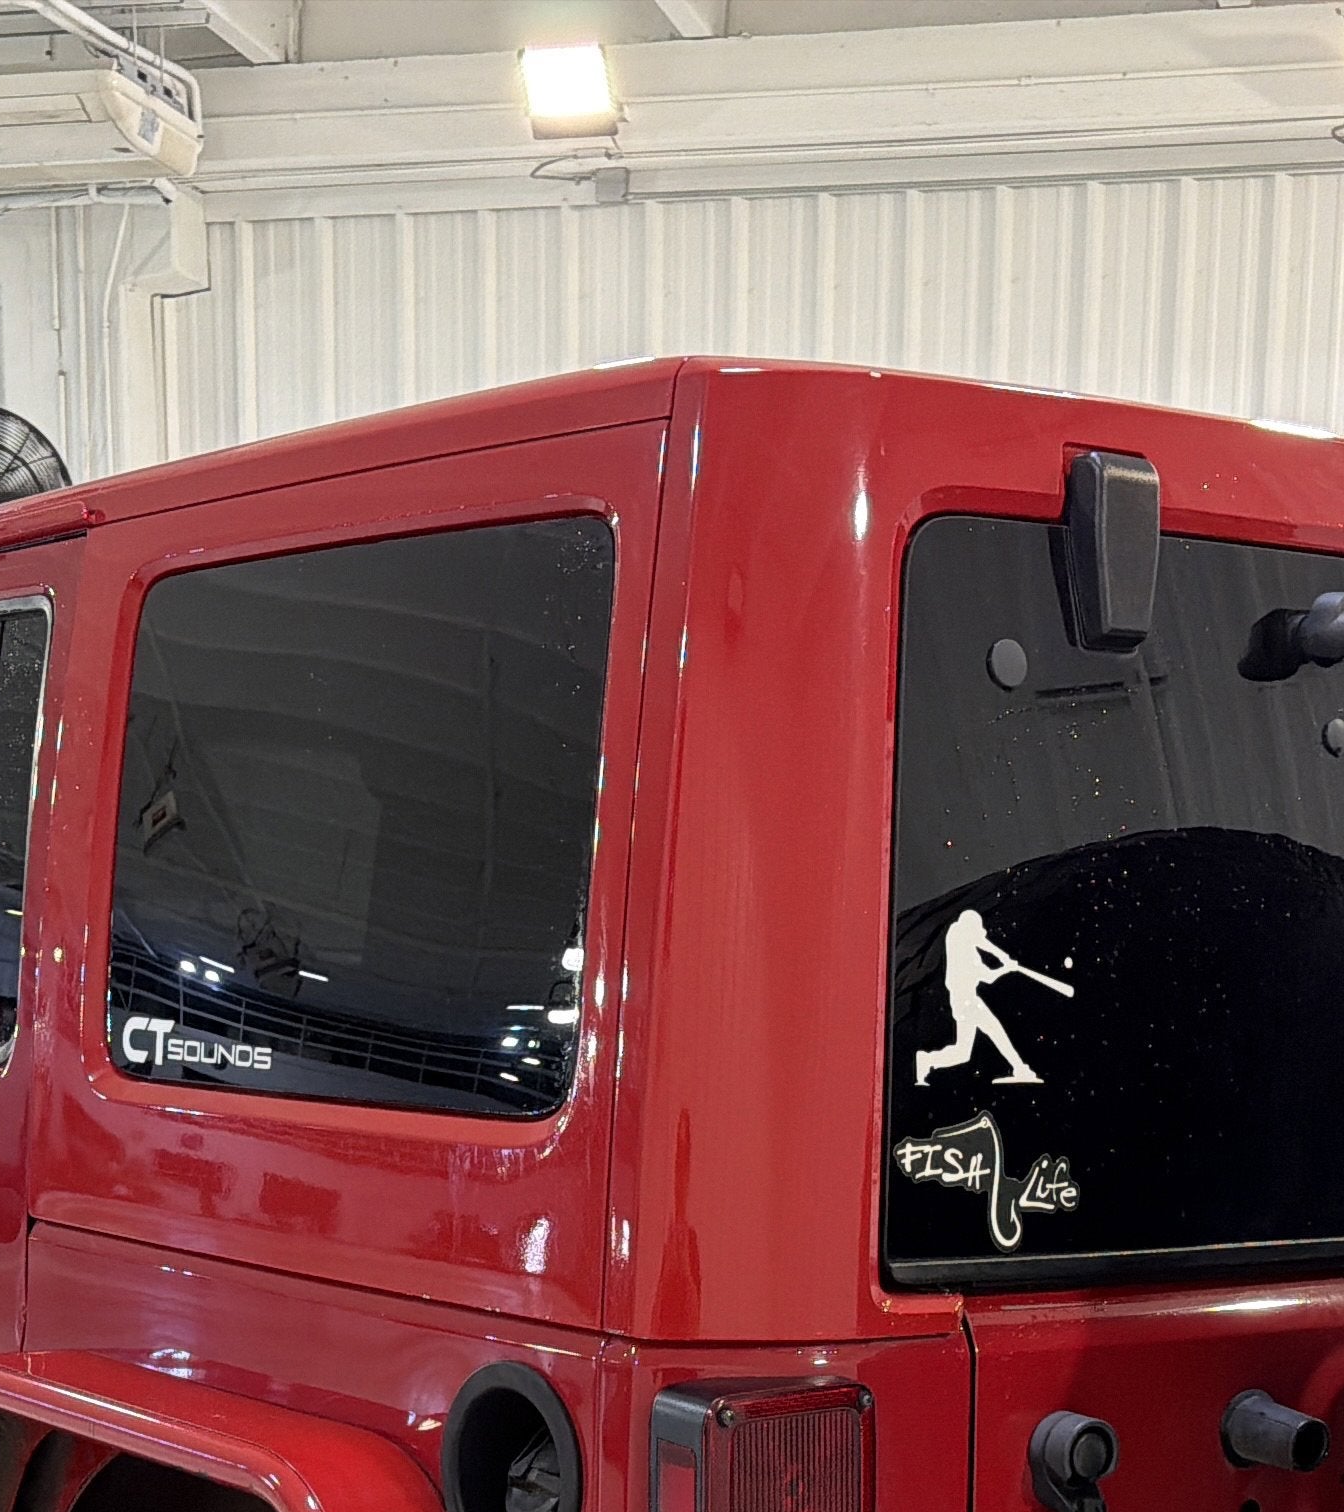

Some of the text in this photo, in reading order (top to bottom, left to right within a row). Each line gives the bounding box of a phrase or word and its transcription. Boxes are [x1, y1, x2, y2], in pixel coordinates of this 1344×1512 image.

[122, 1016, 273, 1070] CT SOUNDS
[896, 1142, 1078, 1211] FISH Life
